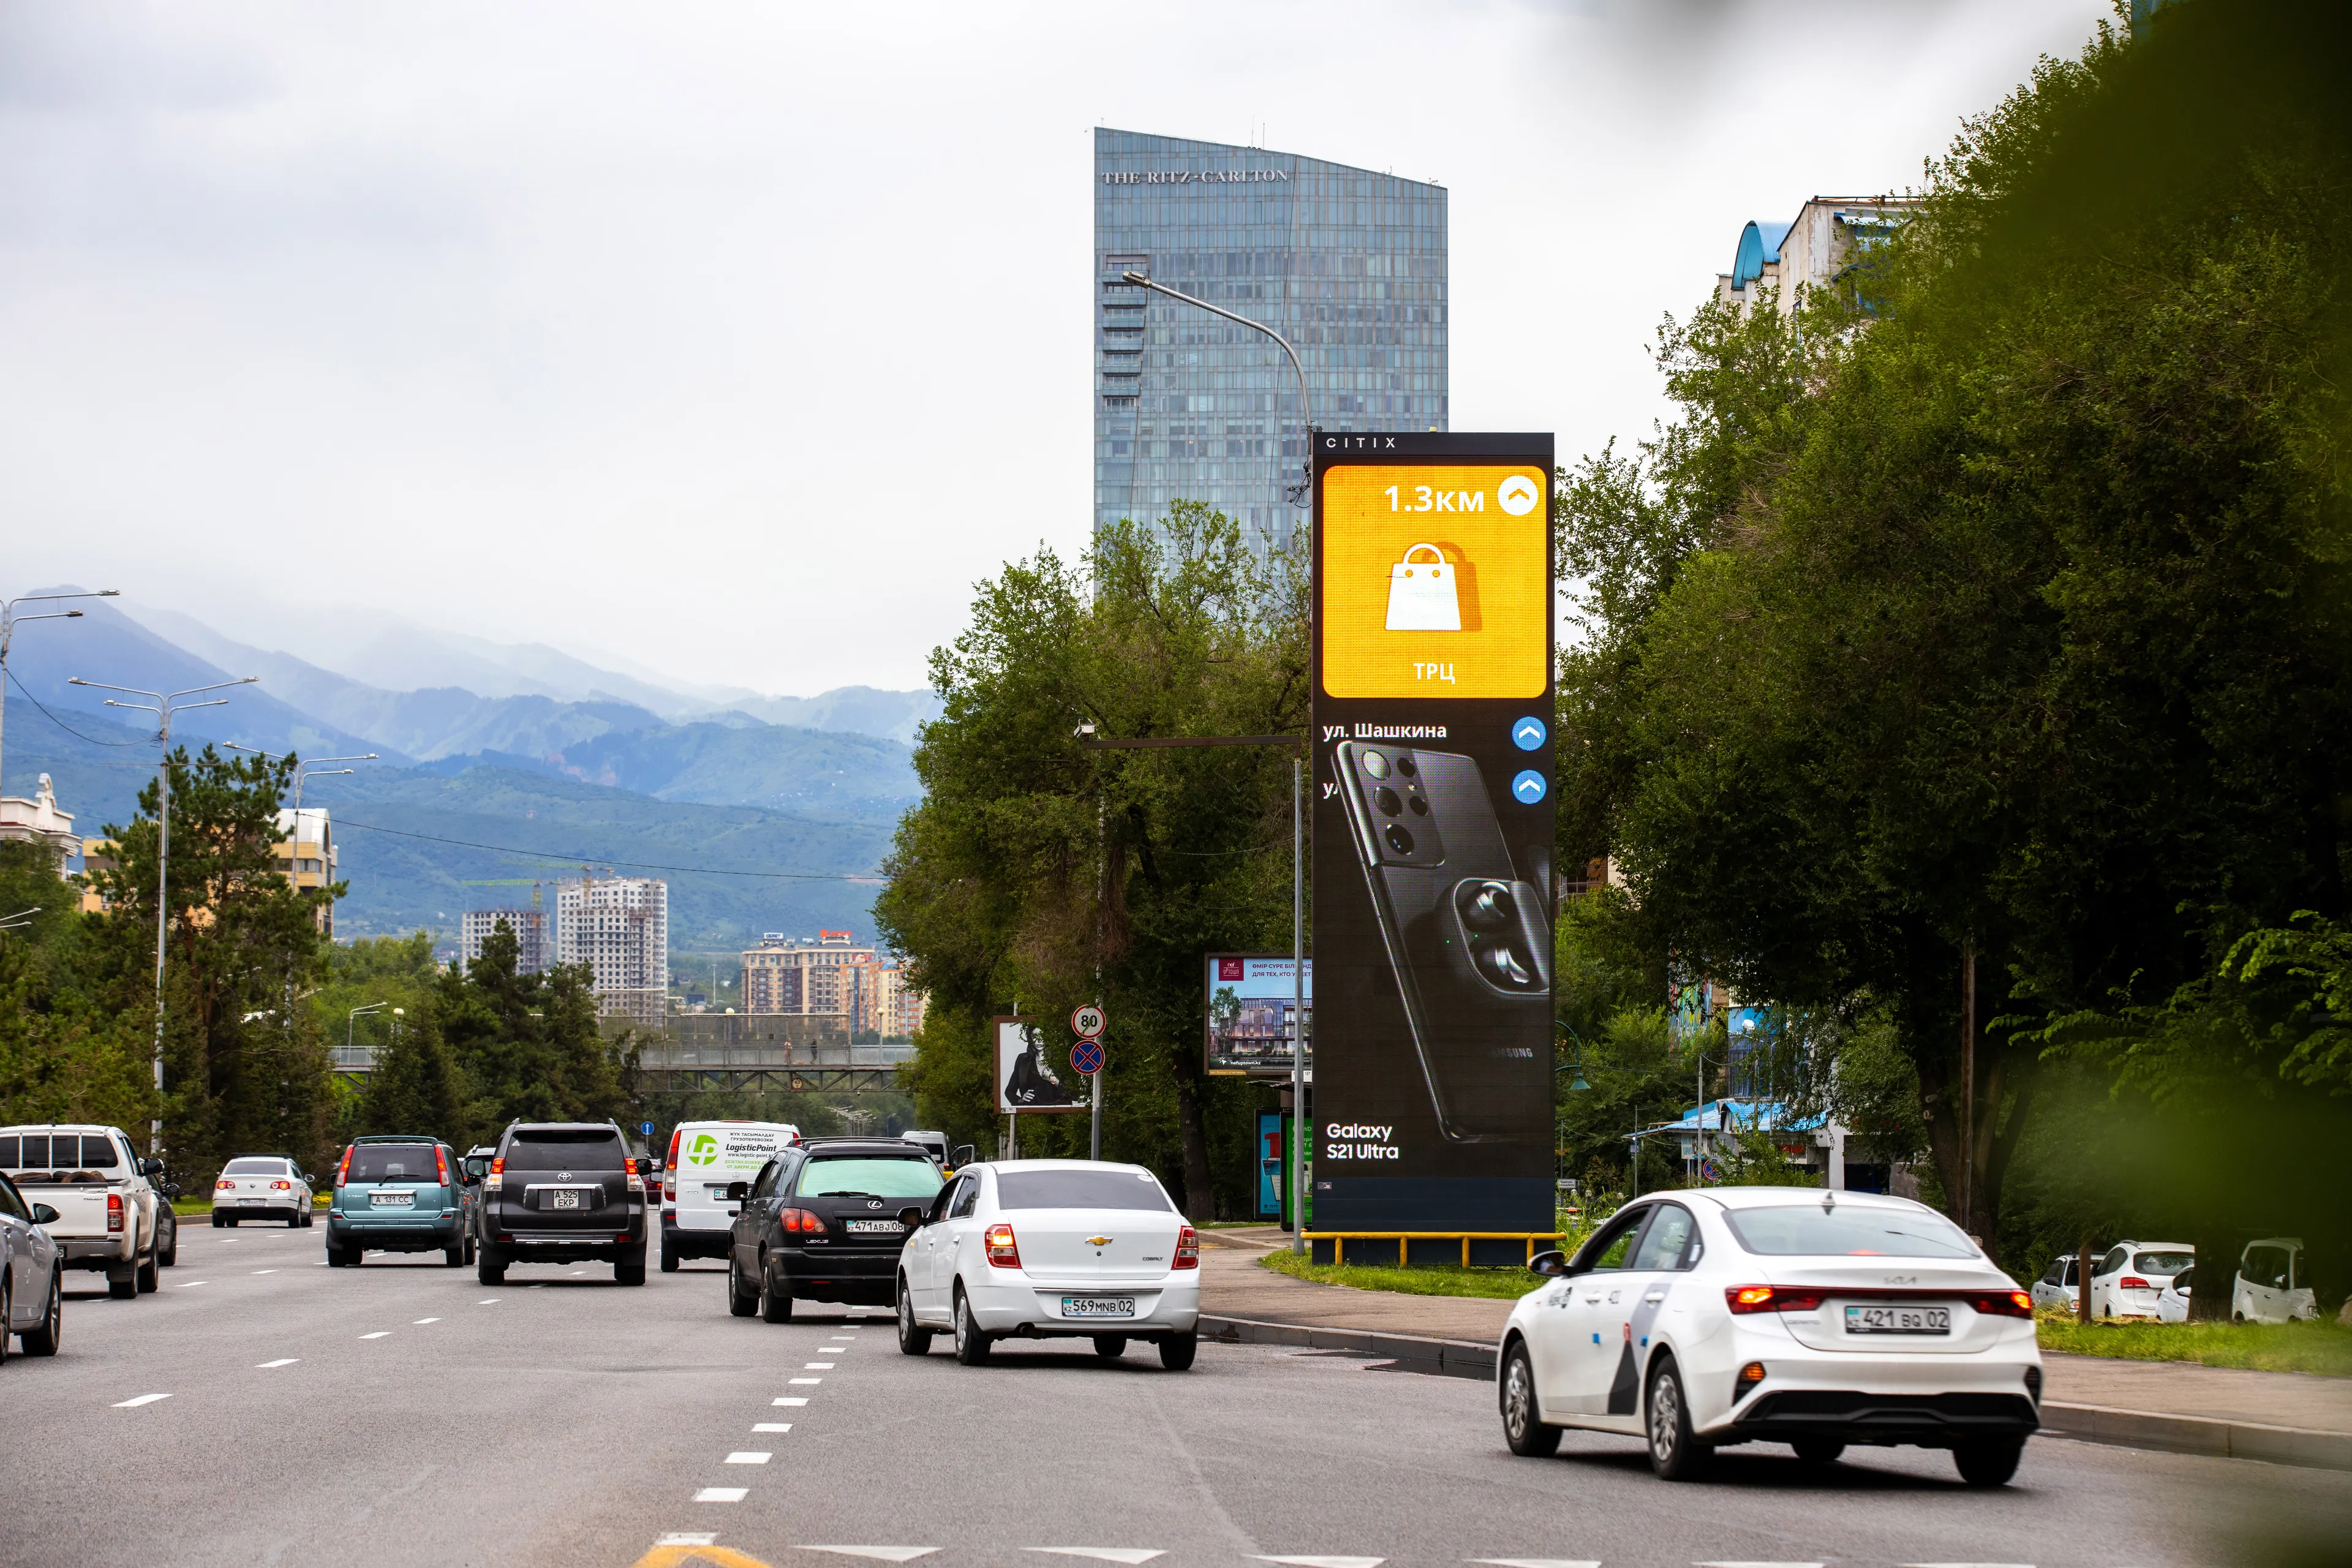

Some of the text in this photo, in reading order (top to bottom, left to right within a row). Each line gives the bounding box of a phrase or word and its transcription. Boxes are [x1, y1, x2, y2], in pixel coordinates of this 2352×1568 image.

[1102, 169, 1289, 184] THE RITZ-CARLTON
[1326, 437, 1395, 448] CITIX
[1413, 663, 1456, 685] ТРЦ
[1322, 723, 1447, 742] ул. Шашкина
[1080, 1015, 1098, 1028] 80
[1326, 1123, 1393, 1142] Galaxy
[725, 1144, 777, 1153] LogisticPoint
[1326, 1144, 1399, 1159] S21 Ultra
[892, 1221, 903, 1231] 08
[1118, 1300, 1133, 1312] 02
[1863, 1310, 1895, 1327] 421
[1927, 1311, 1948, 1328] 02
